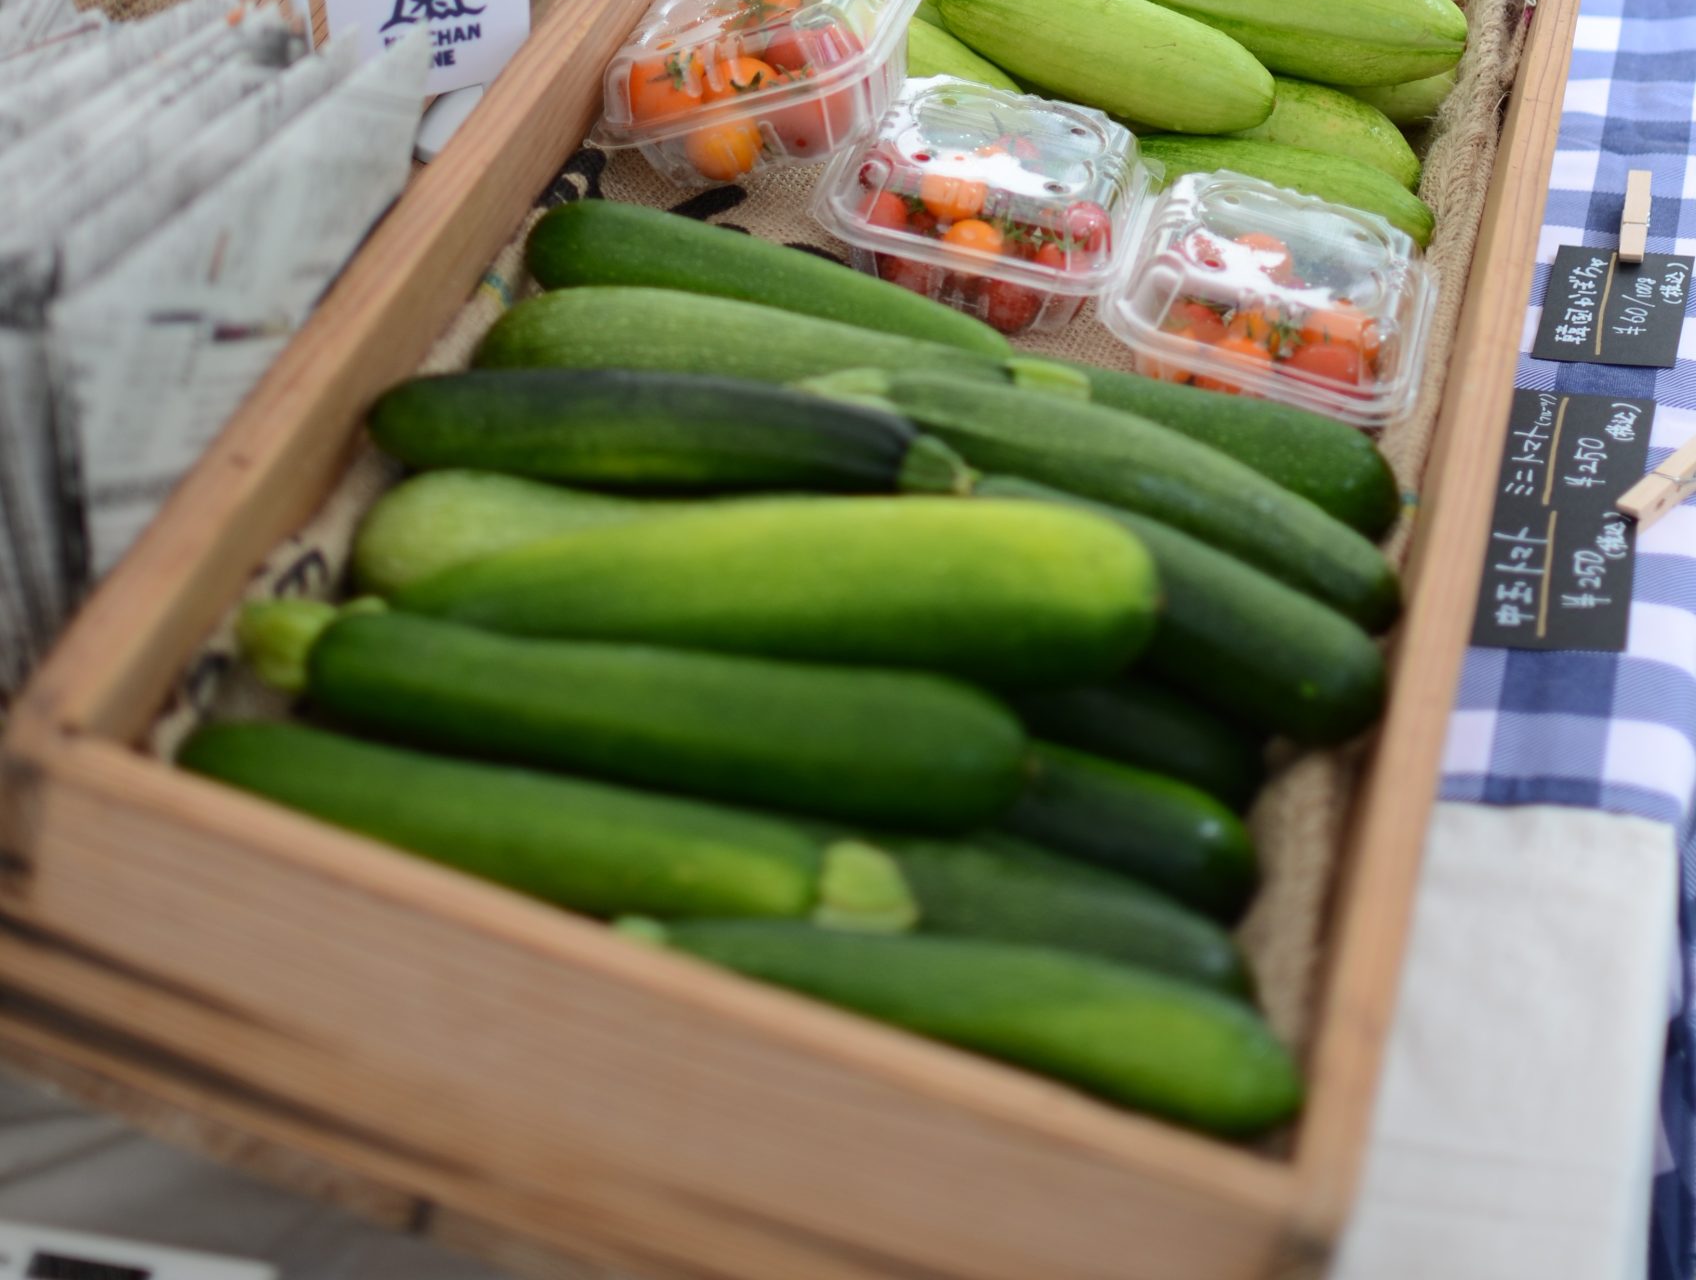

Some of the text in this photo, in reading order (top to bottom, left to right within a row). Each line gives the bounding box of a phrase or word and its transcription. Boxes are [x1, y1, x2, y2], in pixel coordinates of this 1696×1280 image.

[1554, 257, 1608, 345] 韓国かぼちゃ
[1563, 437, 1608, 488] ¥250
[1493, 527, 1549, 626] 中玉トマト
[1561, 550, 1612, 609] ¥250
